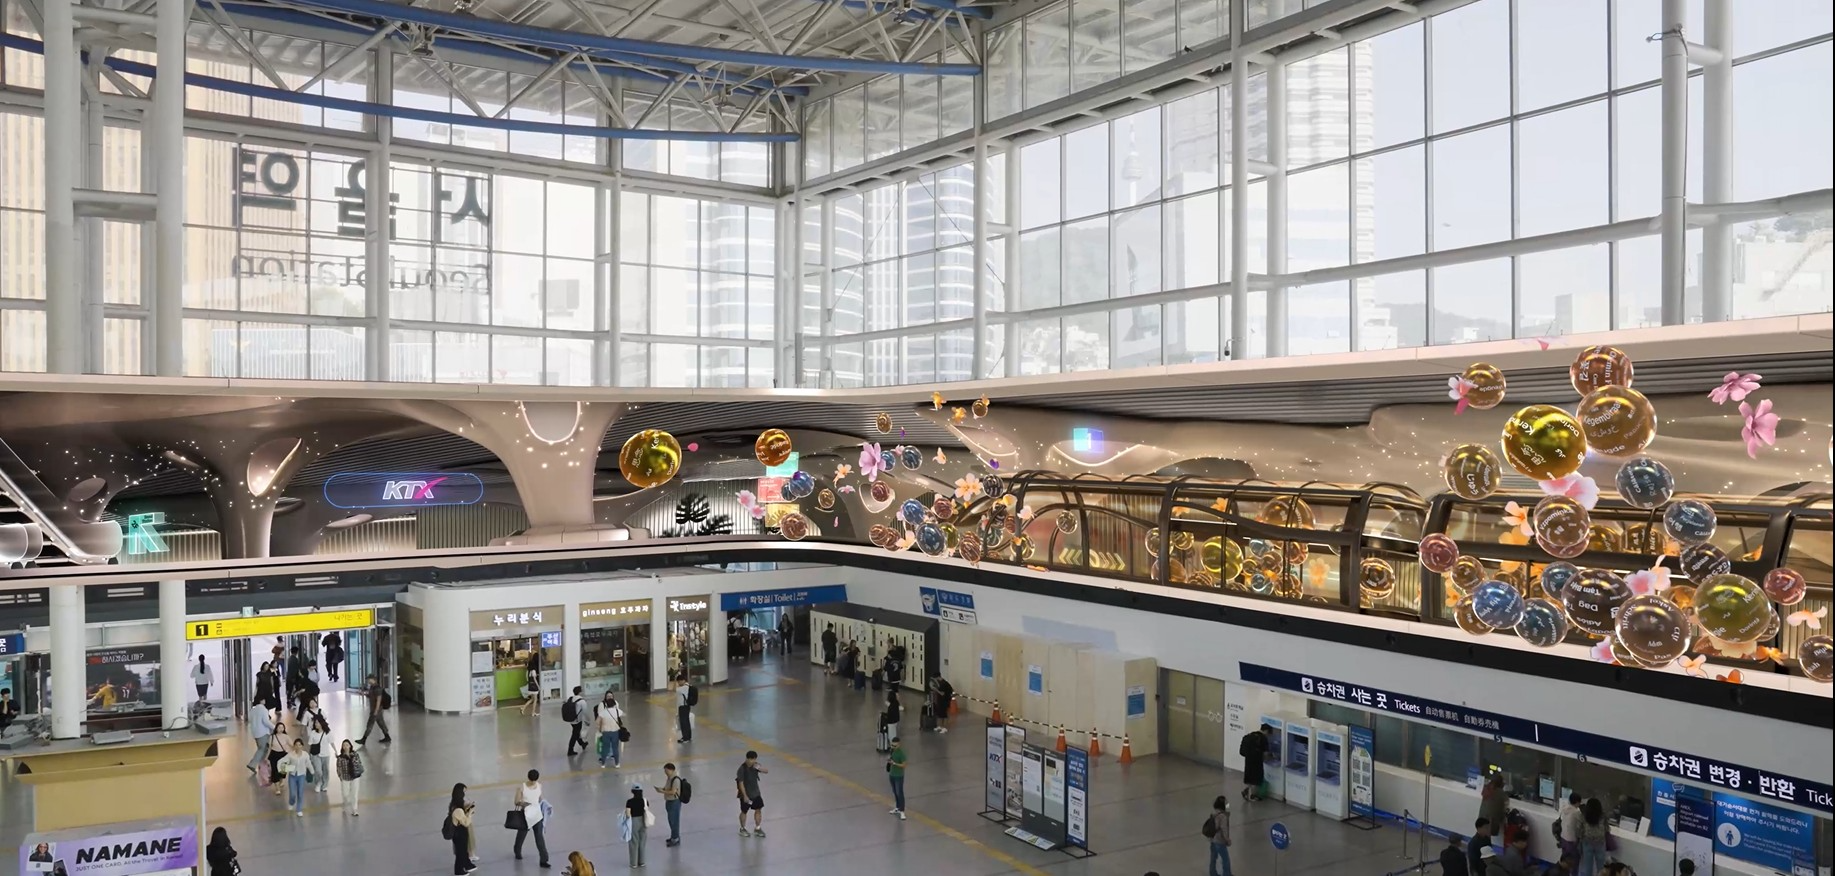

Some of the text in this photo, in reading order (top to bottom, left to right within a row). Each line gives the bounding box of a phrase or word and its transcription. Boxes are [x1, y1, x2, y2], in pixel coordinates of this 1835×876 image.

[382, 476, 449, 500] KTX
[750, 594, 771, 604] 화장실
[774, 593, 793, 603] Toilet
[582, 607, 617, 617] ginseng
[1578, 600, 1599, 612] Dag
[493, 611, 542, 626] 누리분식
[1317, 680, 1421, 714] 승차권 사는 곳 Tickets
[1578, 754, 1586, 763] 6
[1652, 751, 1702, 779] 승차권
[1708, 763, 1742, 788] 변경
[1759, 773, 1796, 801] 반환
[75, 837, 183, 865] NAMANE
[75, 864, 91, 872] JUST
